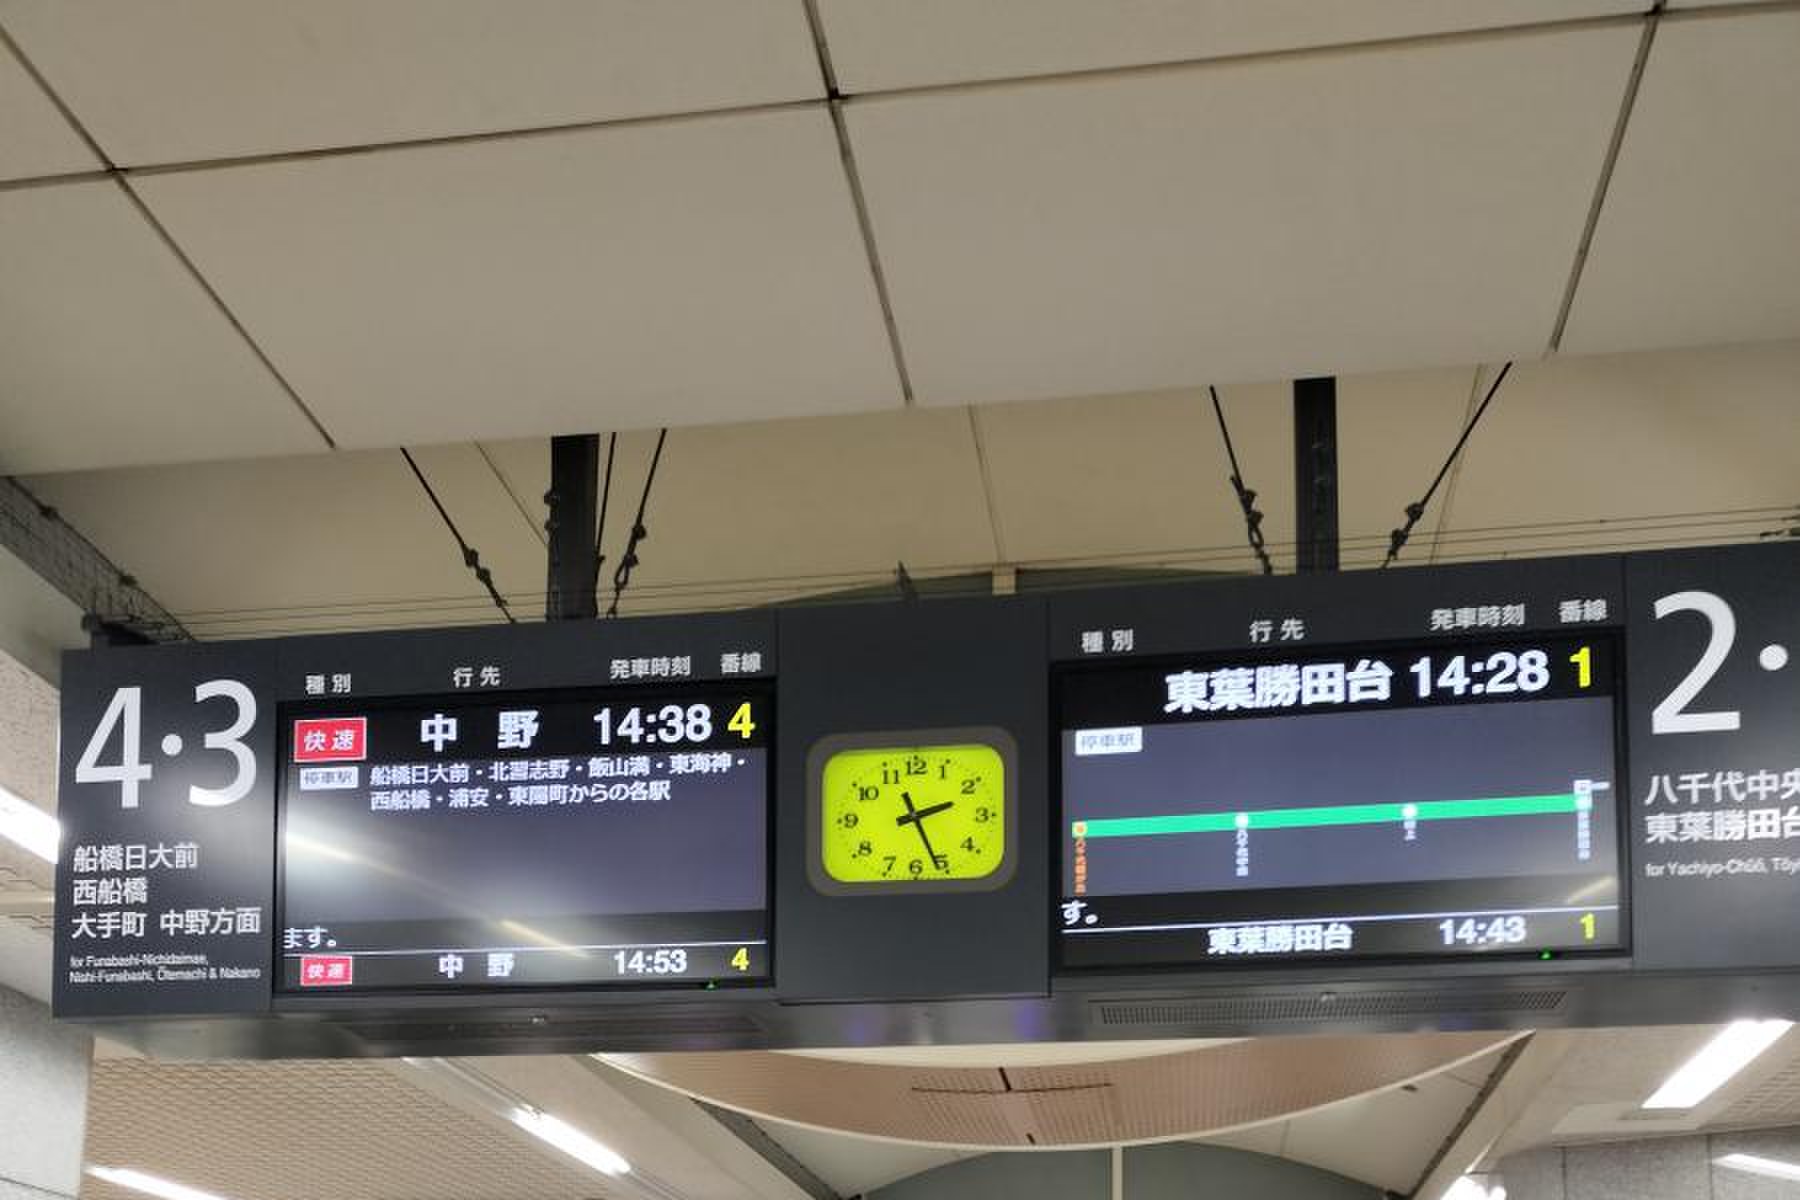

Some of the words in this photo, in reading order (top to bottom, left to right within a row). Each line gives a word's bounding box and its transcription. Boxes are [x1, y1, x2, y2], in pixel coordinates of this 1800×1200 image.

[1081, 628, 1135, 653] 種別
[1249, 618, 1305, 643] 行先
[1430, 603, 1526, 631] 発車時刻
[1558, 599, 1608, 624] 番線
[304, 673, 351, 695] 種別
[453, 666, 501, 688] 行先
[609, 655, 691, 680] 発車時刻
[720, 652, 762, 674] 番線
[1164, 658, 1394, 714] 東葉勝田台
[1409, 649, 1550, 698] 14:28
[1569, 645, 1592, 688] 1
[303, 728, 355, 752] 快速
[593, 702, 712, 745] 14:38
[727, 701, 757, 740] 4
[882, 769, 901, 785] 11
[904, 760, 928, 777] 12
[937, 764, 947, 780] 1
[857, 785, 879, 802] 10
[961, 779, 976, 795] 2
[1644, 767, 1800, 806] 八千代中央
[843, 813, 859, 828] 9
[975, 808, 989, 824] 3
[1644, 805, 1800, 845] 東葉勝田台
[857, 841, 873, 857] 8
[959, 836, 975, 851] 4
[73, 842, 199, 873] 船橋日大前
[882, 856, 897, 872] 7
[908, 858, 923, 875] 6
[1645, 862, 1665, 877] for
[72, 877, 148, 907] 西船橋
[71, 911, 147, 940] 大手町
[159, 907, 263, 936] 中野方面
[283, 926, 337, 949] ます。
[1207, 923, 1353, 956] 東葉勝田台
[1439, 916, 1527, 946] 14:43
[1580, 913, 1596, 940] 1
[613, 949, 688, 974] 14:53
[731, 948, 750, 972] 4
[209, 968, 217, 979] &
[220, 967, 261, 980] Nakano
